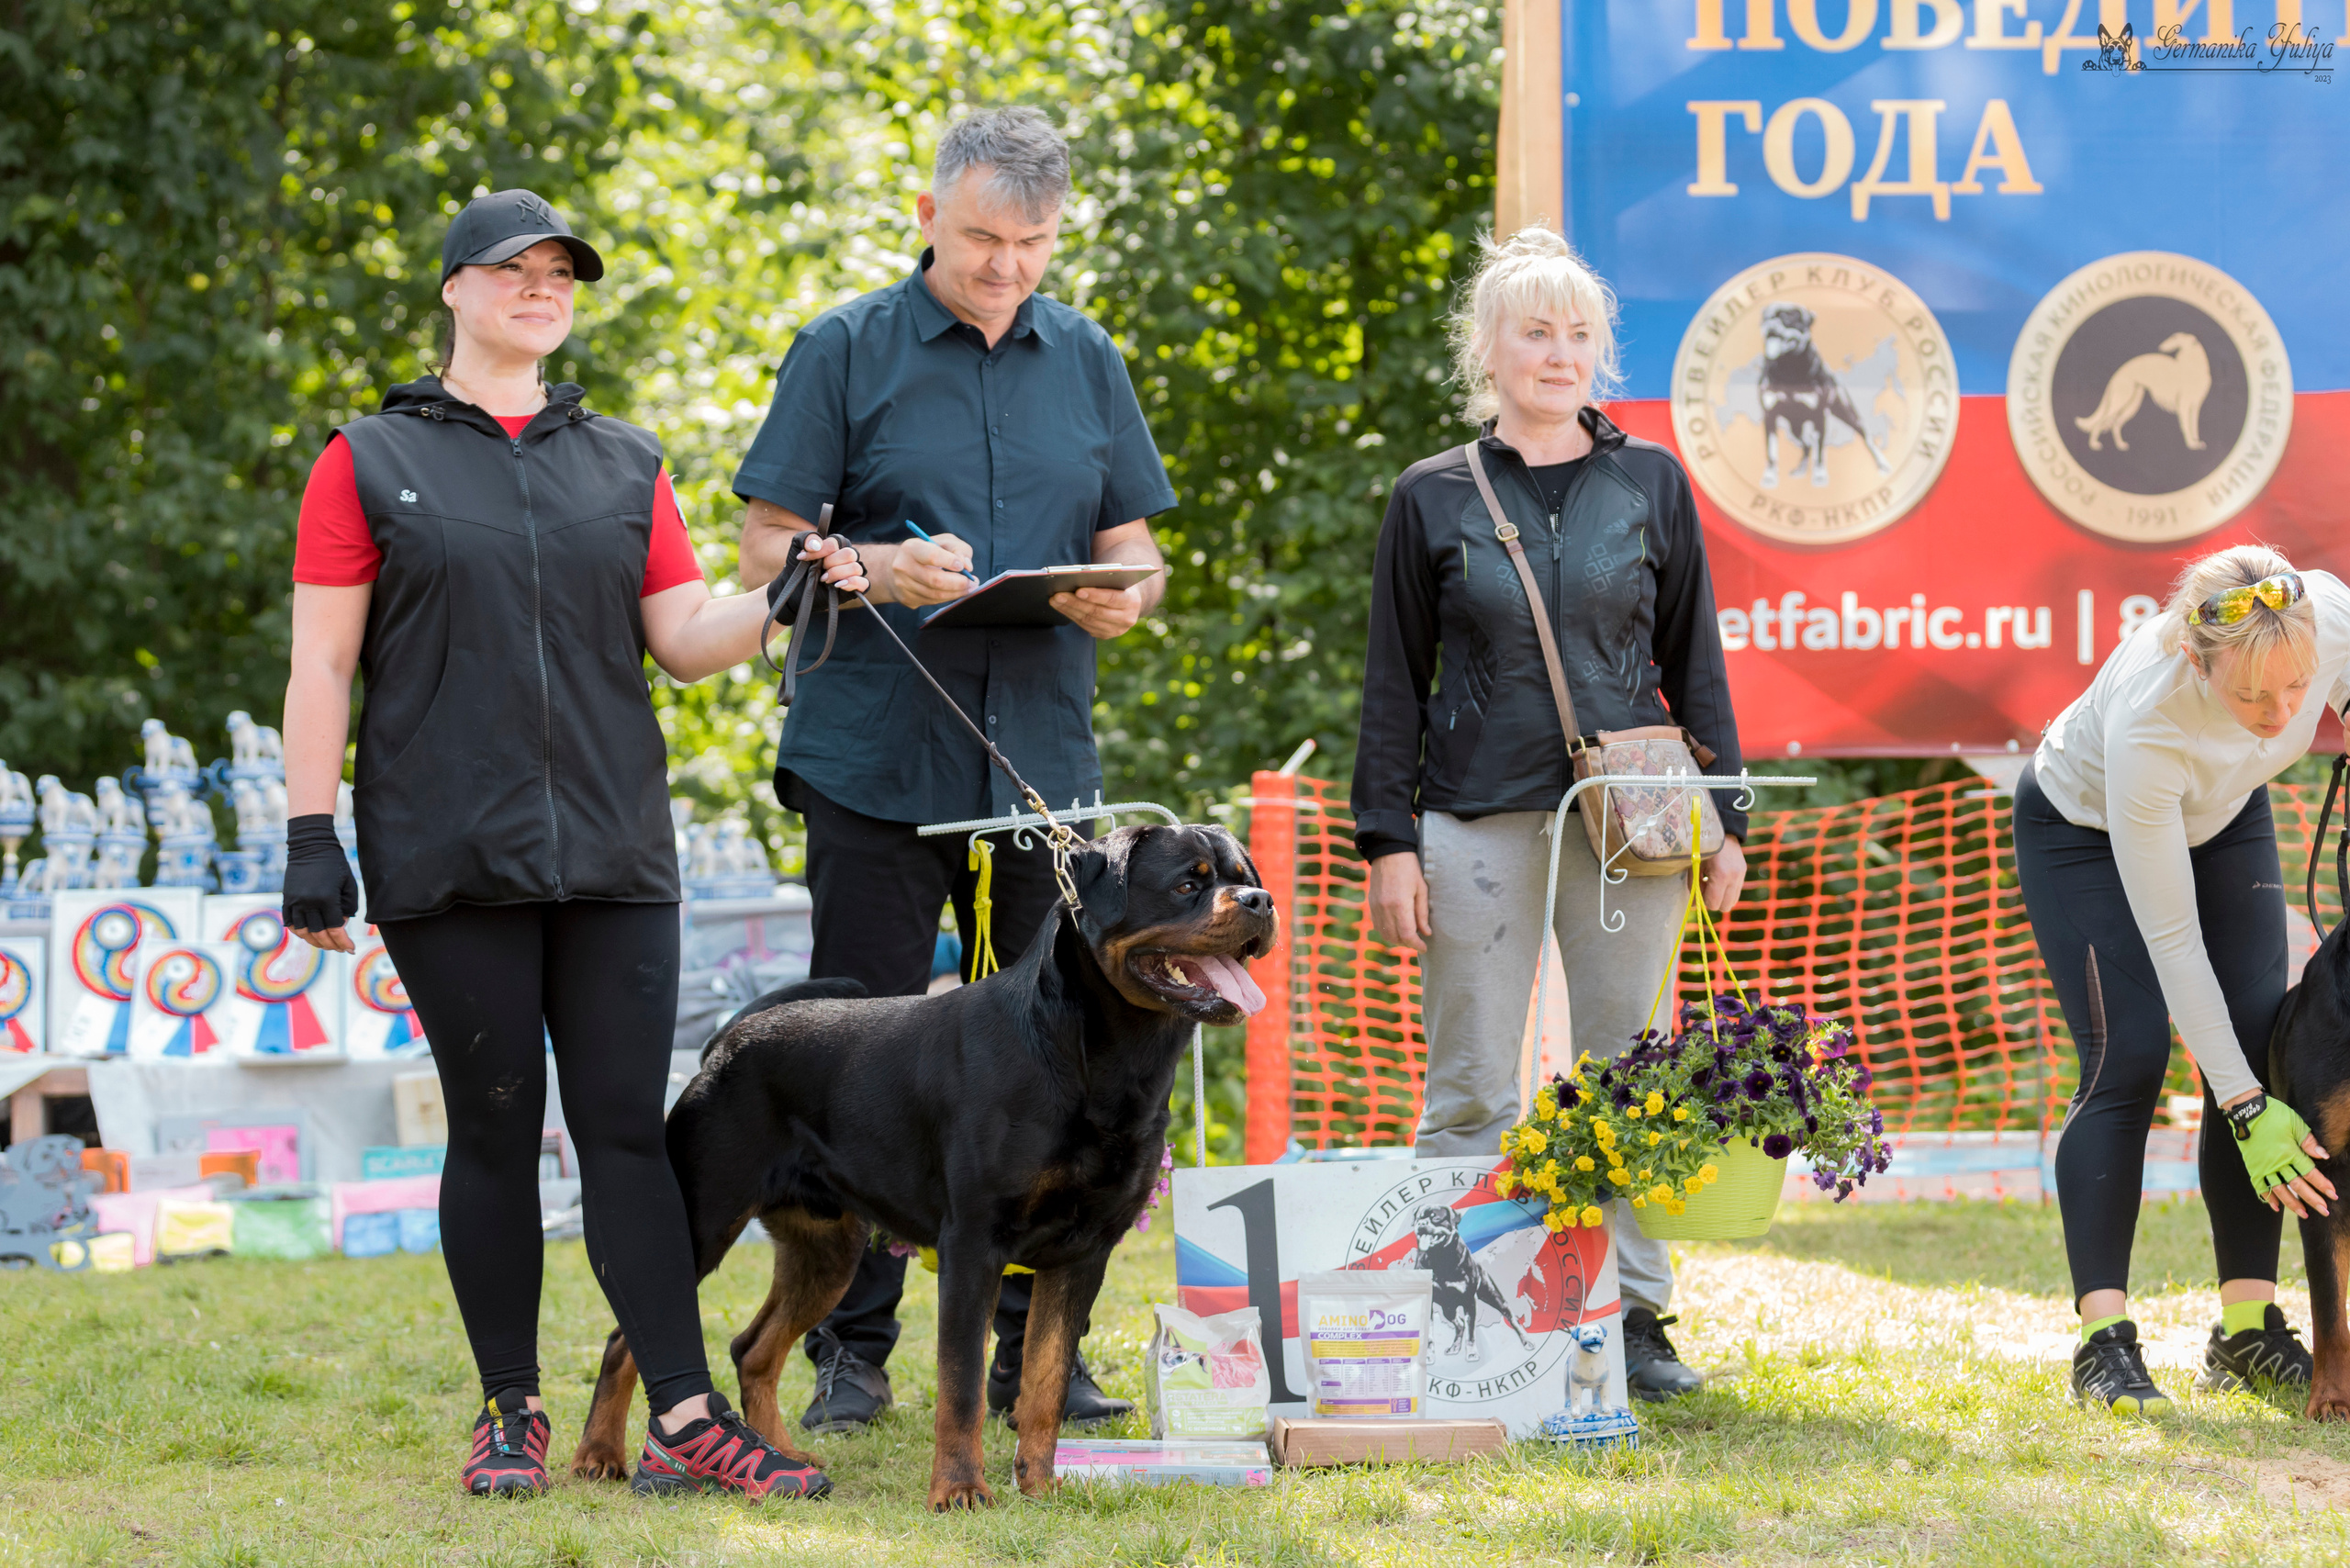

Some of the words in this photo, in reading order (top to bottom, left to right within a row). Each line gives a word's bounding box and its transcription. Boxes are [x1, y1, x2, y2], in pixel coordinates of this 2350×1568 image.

[1685, 0, 2350, 74] ПОБЕДИТ
[1685, 96, 2044, 221] ГОДА
[2047, 262, 2269, 351] КИНОЛОГИЧЕСКАЯ
[1685, 271, 1786, 461] РОТВЕЙЛЕР
[1807, 265, 1897, 308] КЛУБ
[1904, 316, 1949, 461] РОССИИ
[2022, 331, 2098, 506] РОССИЙСКАЯ
[2209, 357, 2281, 507] ФЕДЕРАЦИЯ
[1749, 487, 1894, 527] РКФ-НКПР
[2127, 507, 2179, 525] 1991
[1719, 590, 2053, 651] etfabric.ru
[1451, 1171, 1533, 1204] КЛБ
[1544, 1225, 1581, 1334] ОССИИ
